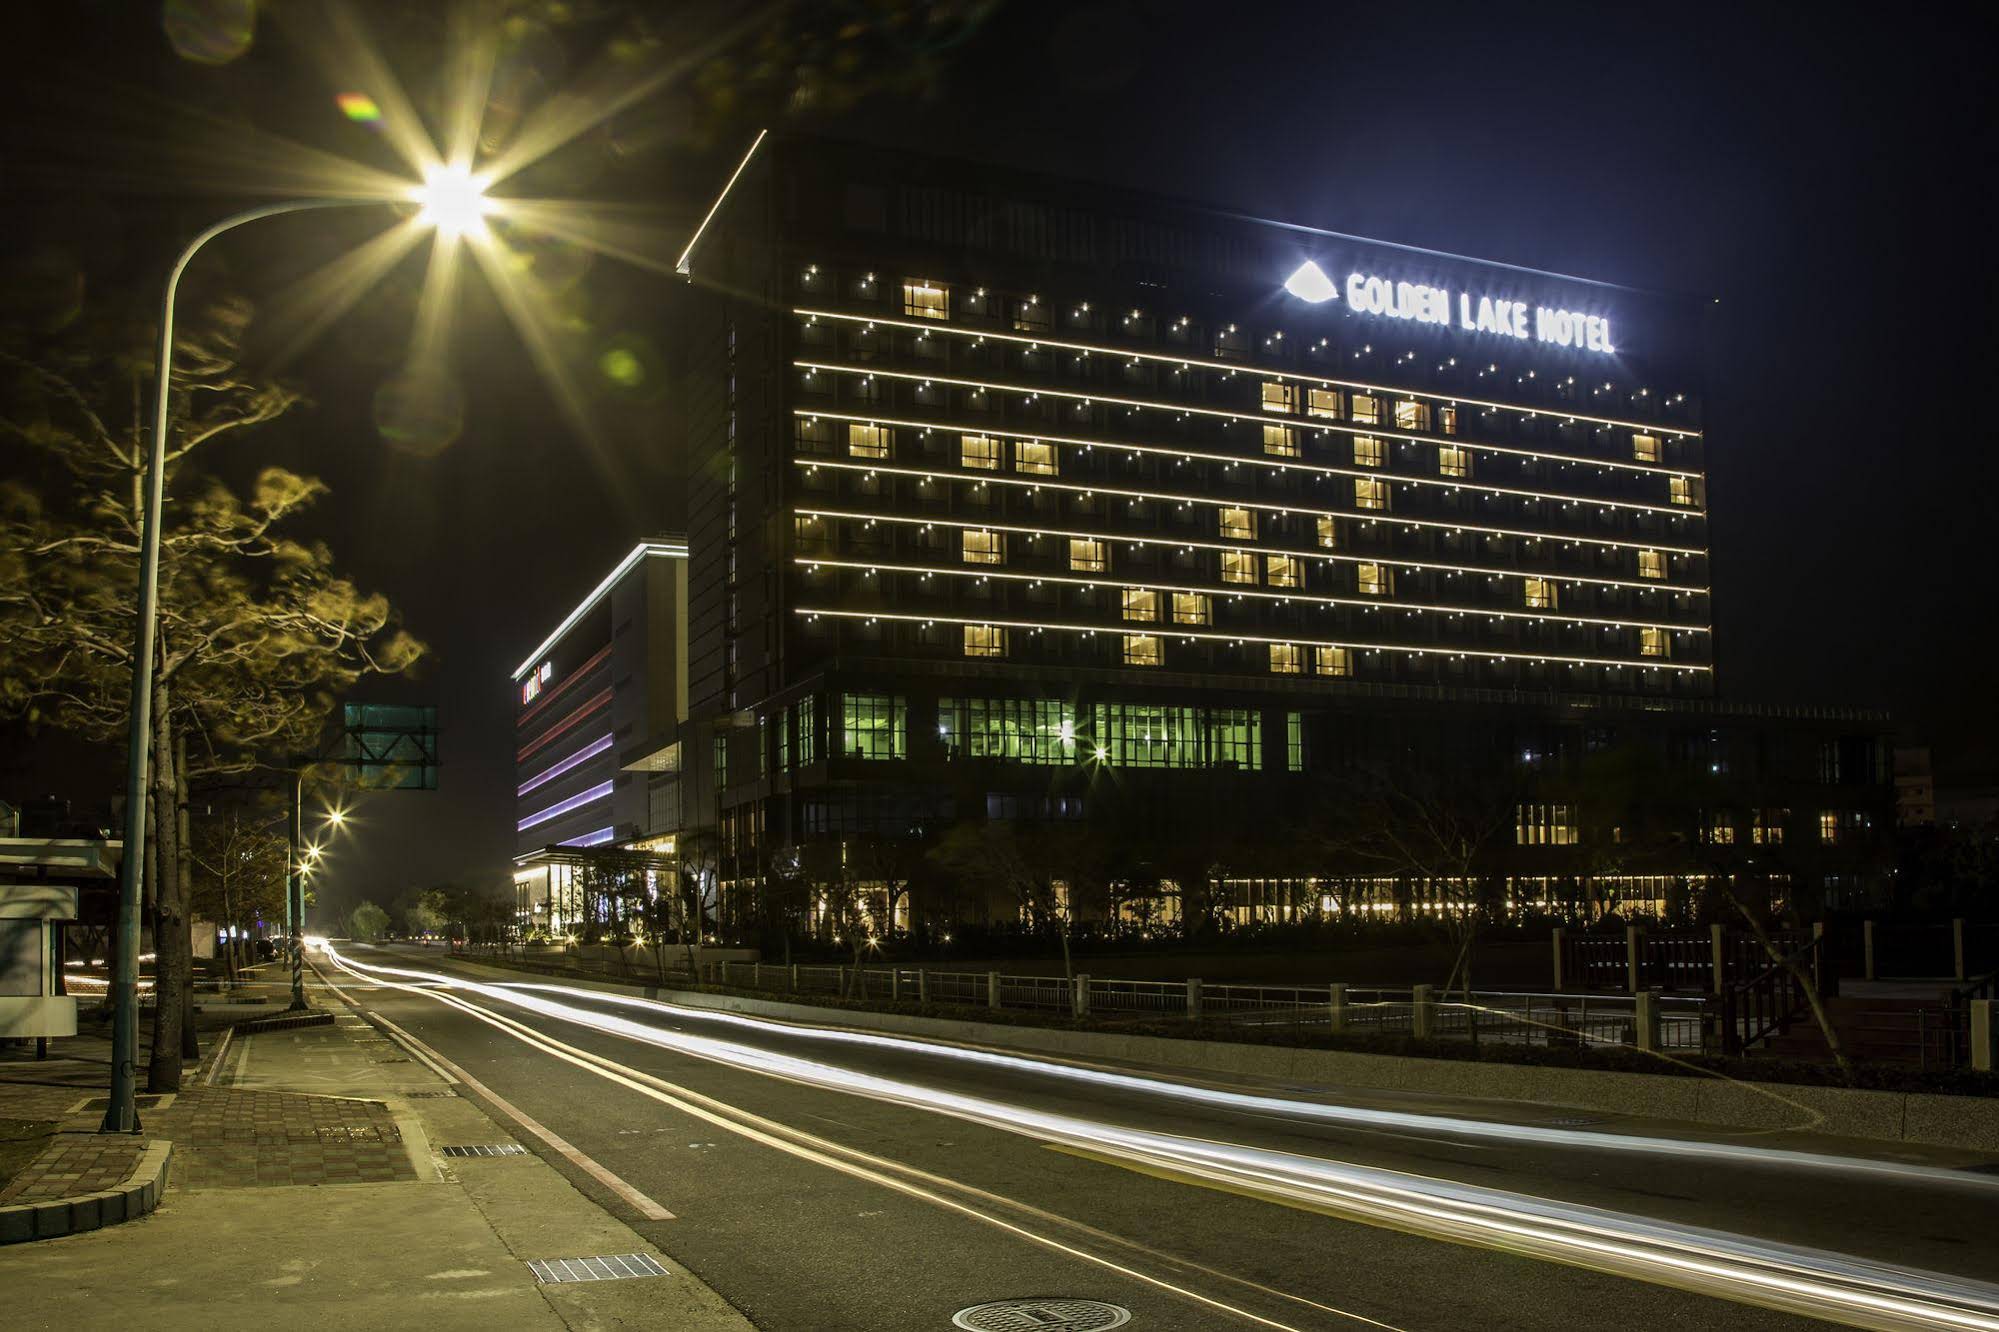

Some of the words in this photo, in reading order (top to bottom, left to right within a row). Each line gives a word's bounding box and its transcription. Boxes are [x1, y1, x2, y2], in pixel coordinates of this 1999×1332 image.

[1347, 273, 1450, 326] GOLDEN
[1460, 293, 1529, 339] LAKE
[1537, 307, 1615, 353] HOTEL
